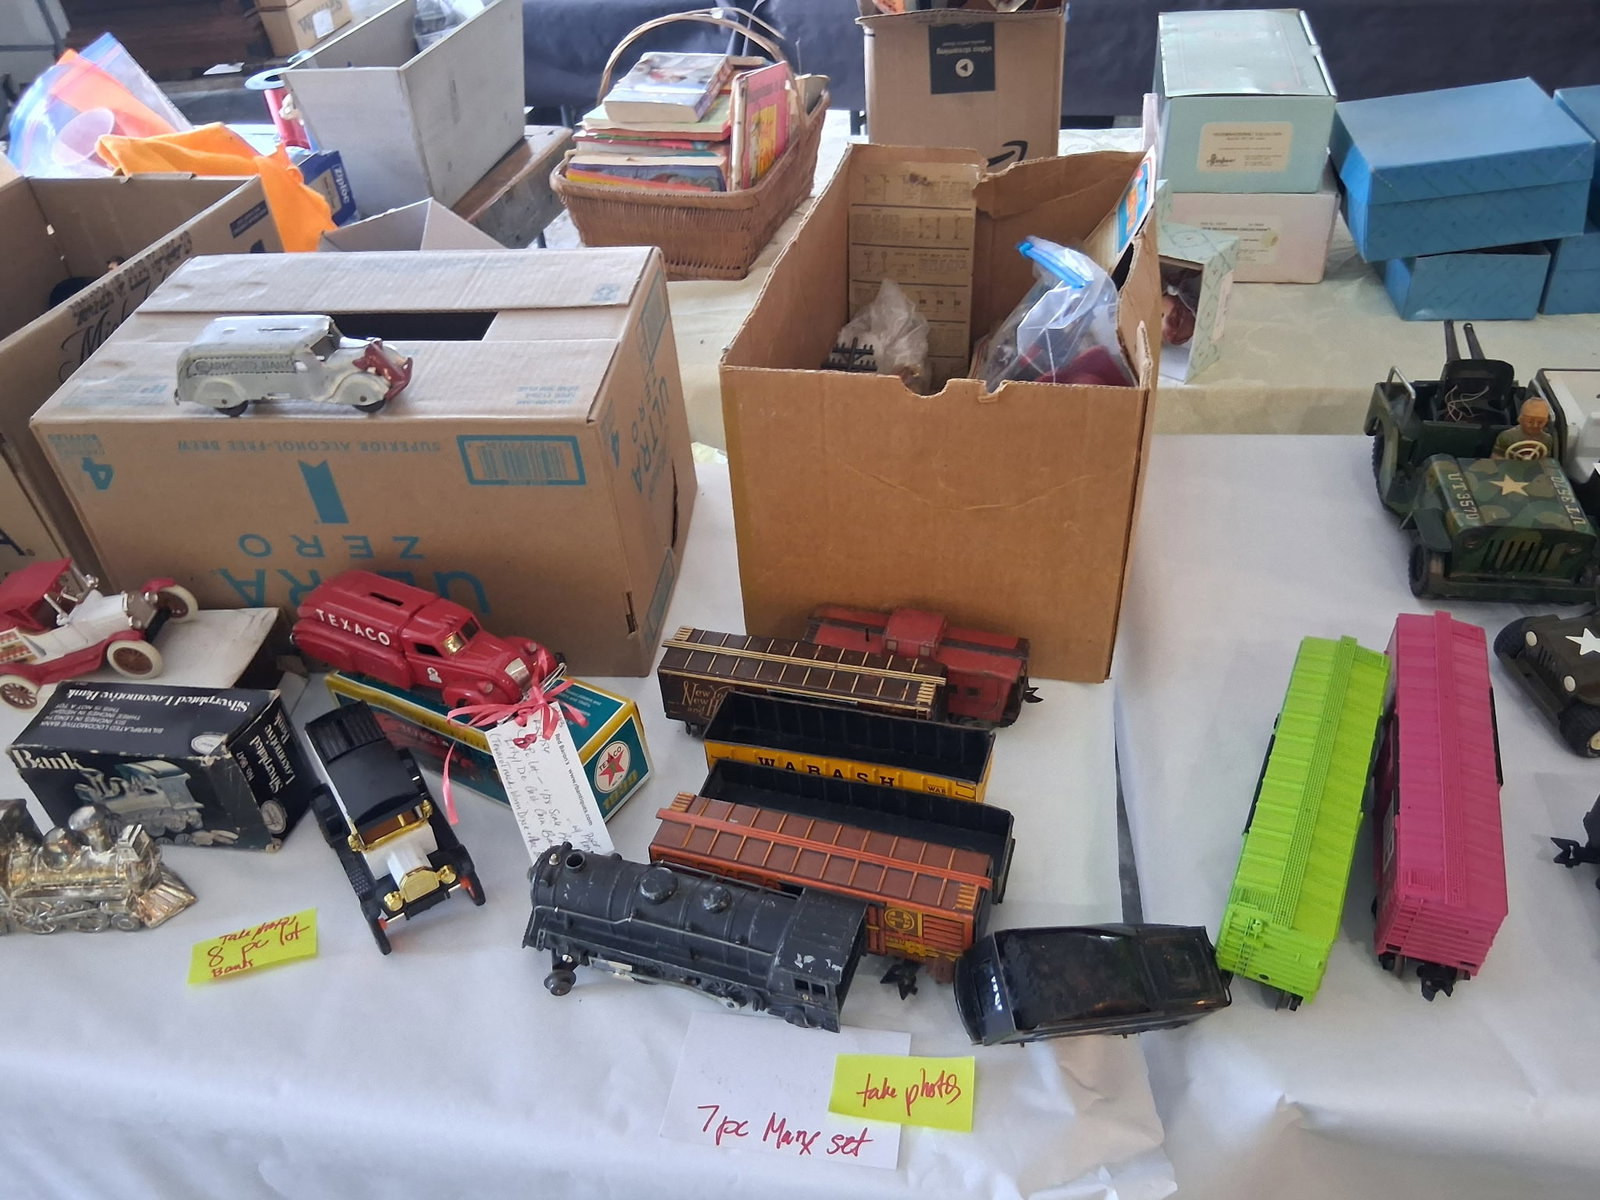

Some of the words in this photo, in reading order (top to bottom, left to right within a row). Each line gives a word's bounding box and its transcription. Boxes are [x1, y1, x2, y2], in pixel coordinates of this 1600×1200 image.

[973, 46, 992, 54] video
[334, 167, 350, 204] Ziploc
[177, 440, 220, 451] BREW
[228, 440, 350, 453] ALCOHOL-FREE
[360, 440, 441, 453] SUPERIOR
[81, 456, 115, 491] 4
[238, 533, 425, 560] ZERO
[218, 567, 492, 616] URA
[315, 608, 391, 646] TEXACO
[67, 688, 99, 700] Bank
[100, 690, 174, 706] Locomotive
[173, 694, 251, 713] Silverplated
[273, 711, 290, 745] Bank
[12, 749, 84, 769] Bank
[249, 734, 283, 794] Silverplated
[264, 723, 296, 785] Locomotive
[757, 756, 895, 788] WABASH
[568, 769, 594, 827] www.rbantiques.com
[207, 945, 225, 968] 8
[279, 921, 311, 946] lot
[856, 1072, 898, 1108] take
[762, 1111, 822, 1156] Marx
[826, 1126, 875, 1157] set
